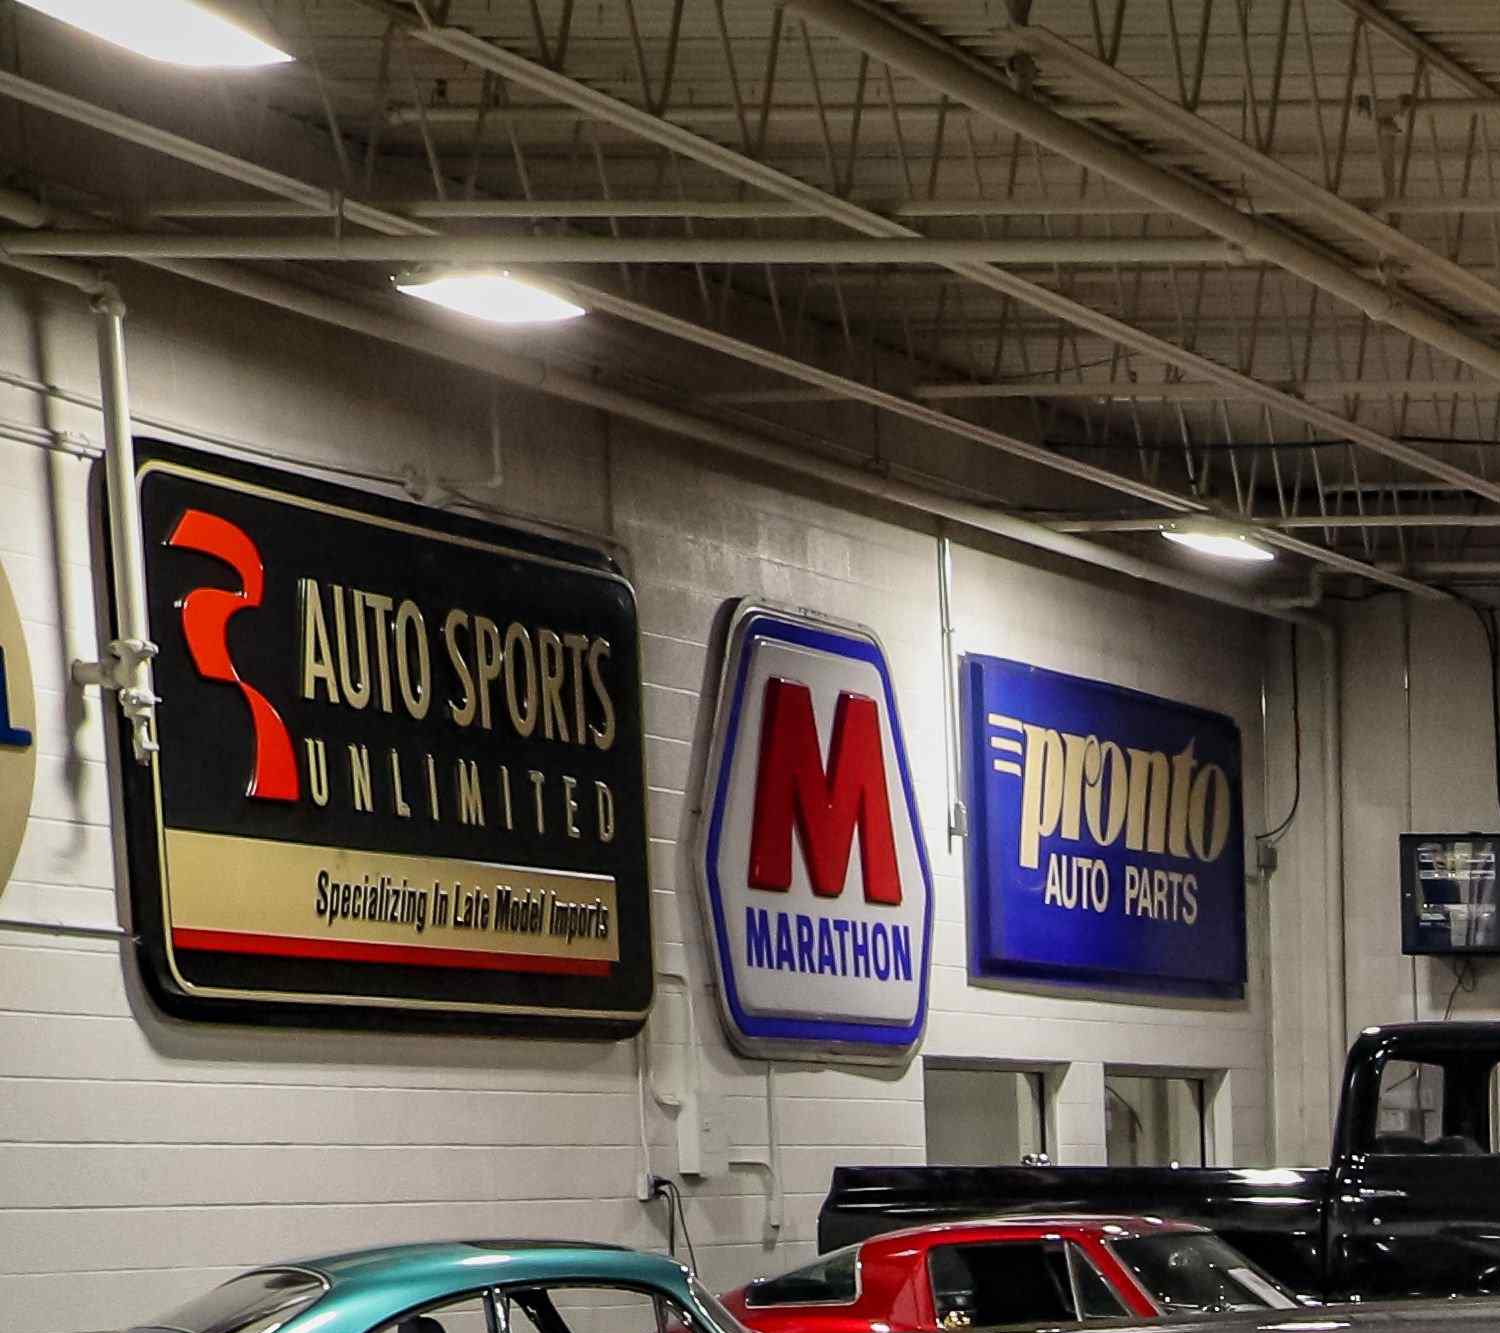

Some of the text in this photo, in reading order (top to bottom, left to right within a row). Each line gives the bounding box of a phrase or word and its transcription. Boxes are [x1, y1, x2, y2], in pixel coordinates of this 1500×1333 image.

[297, 578, 616, 750] AUTO SPORTS
[304, 737, 616, 841] UNLIMITED
[747, 676, 903, 907] M
[1018, 722, 1231, 870] pronto
[315, 870, 610, 945] Specializing In Late Model Imports
[1044, 852, 1199, 925] AUTO PARTS
[745, 906, 913, 981] MARATHON
